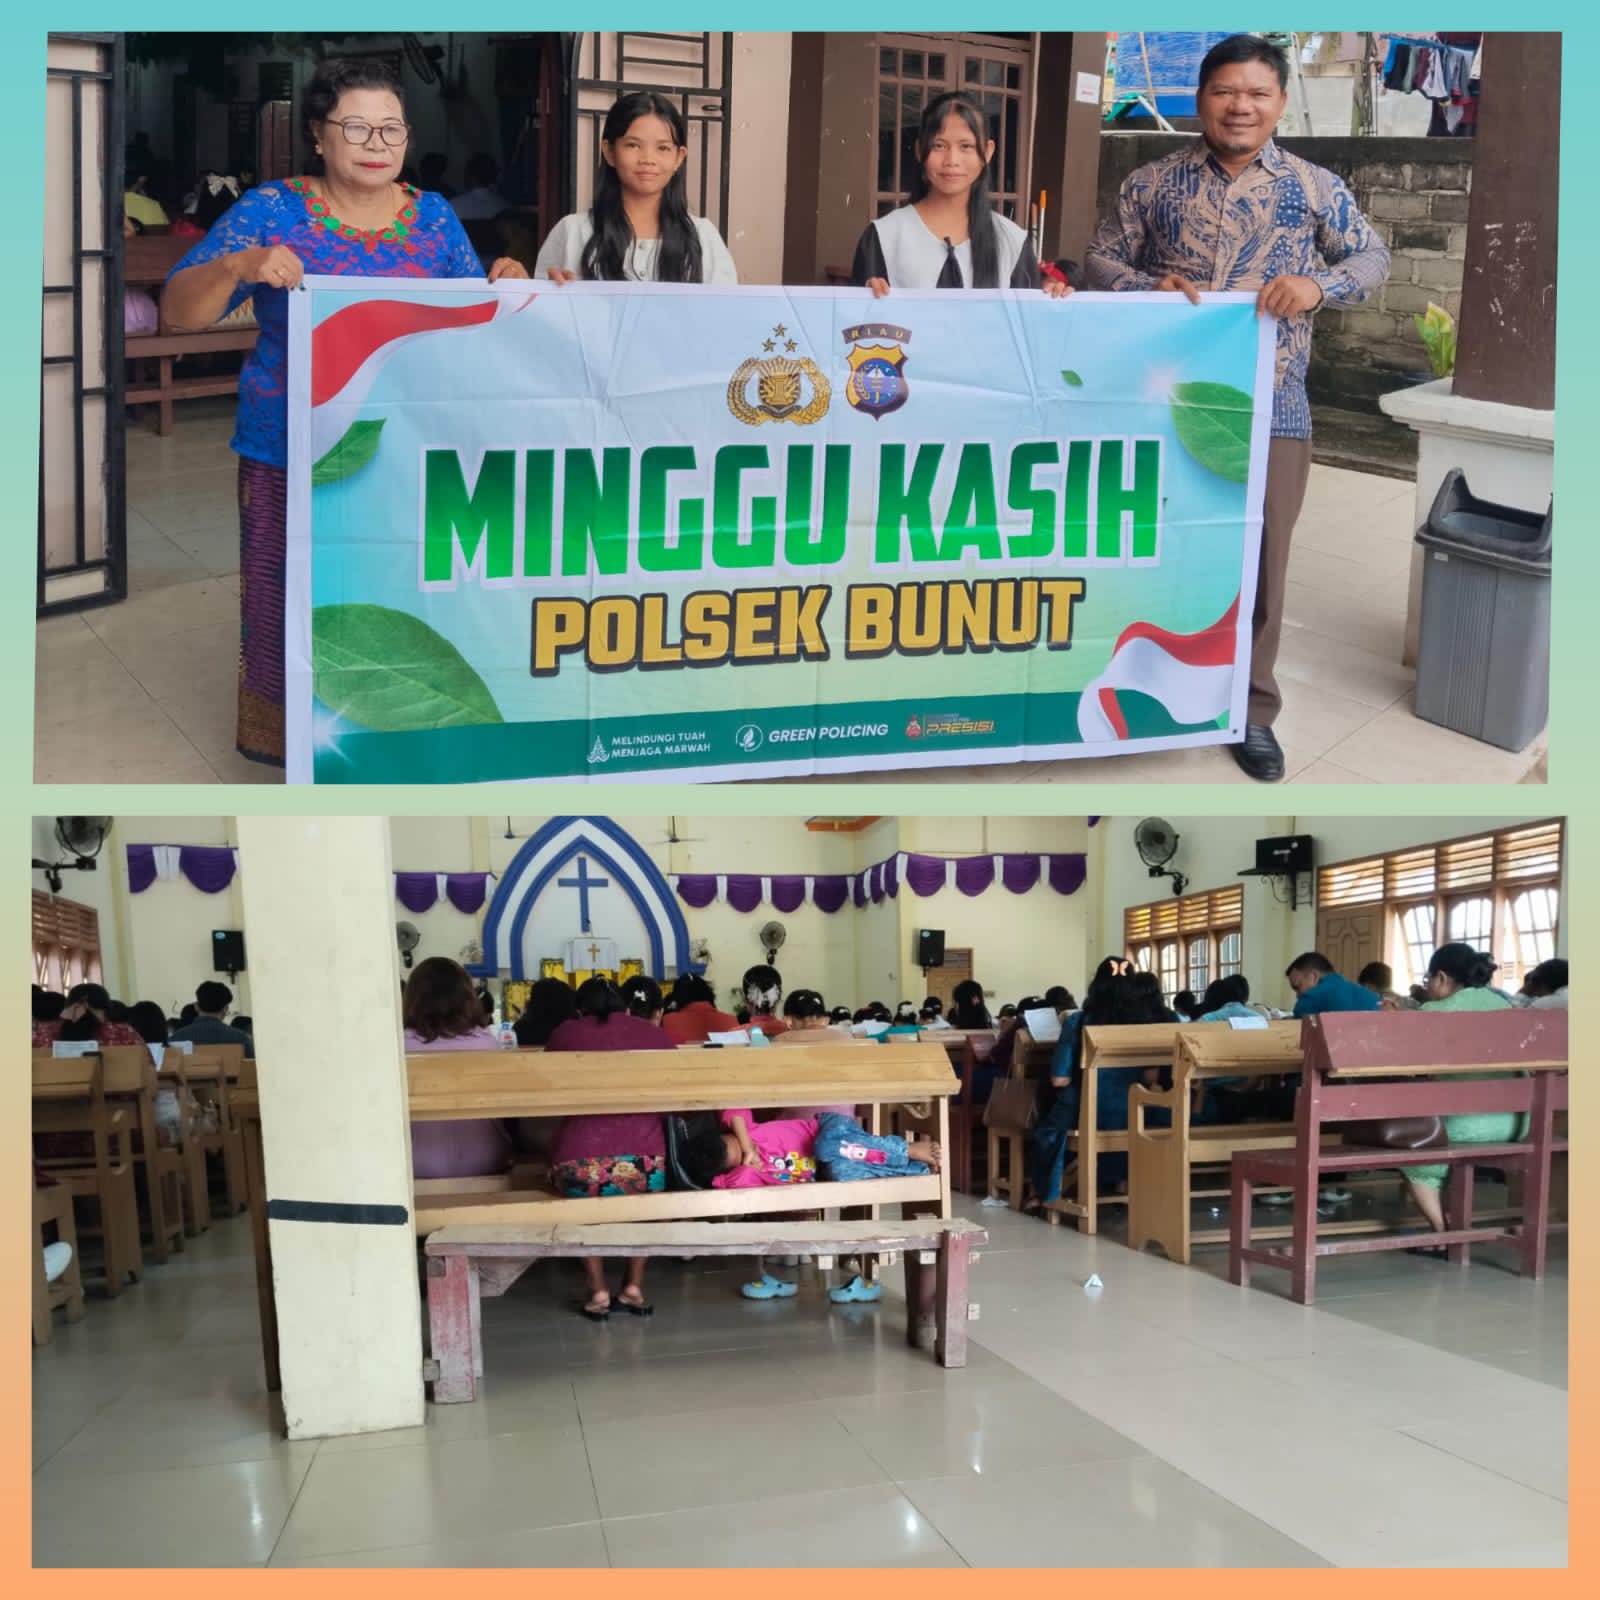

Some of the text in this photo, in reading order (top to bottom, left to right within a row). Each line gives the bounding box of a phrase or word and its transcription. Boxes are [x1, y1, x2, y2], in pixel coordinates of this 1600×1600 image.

[851, 327, 905, 339] RIAU
[420, 439, 1162, 586] MINGGU KASIH
[531, 577, 1085, 676] POLSEK BUNUT
[768, 723, 889, 743] GREEN POLICING
[926, 719, 995, 736] PRESISI
[611, 731, 706, 746] MELINDUNGI TUAH
[611, 743, 711, 759] MENJAGA MARWAH
